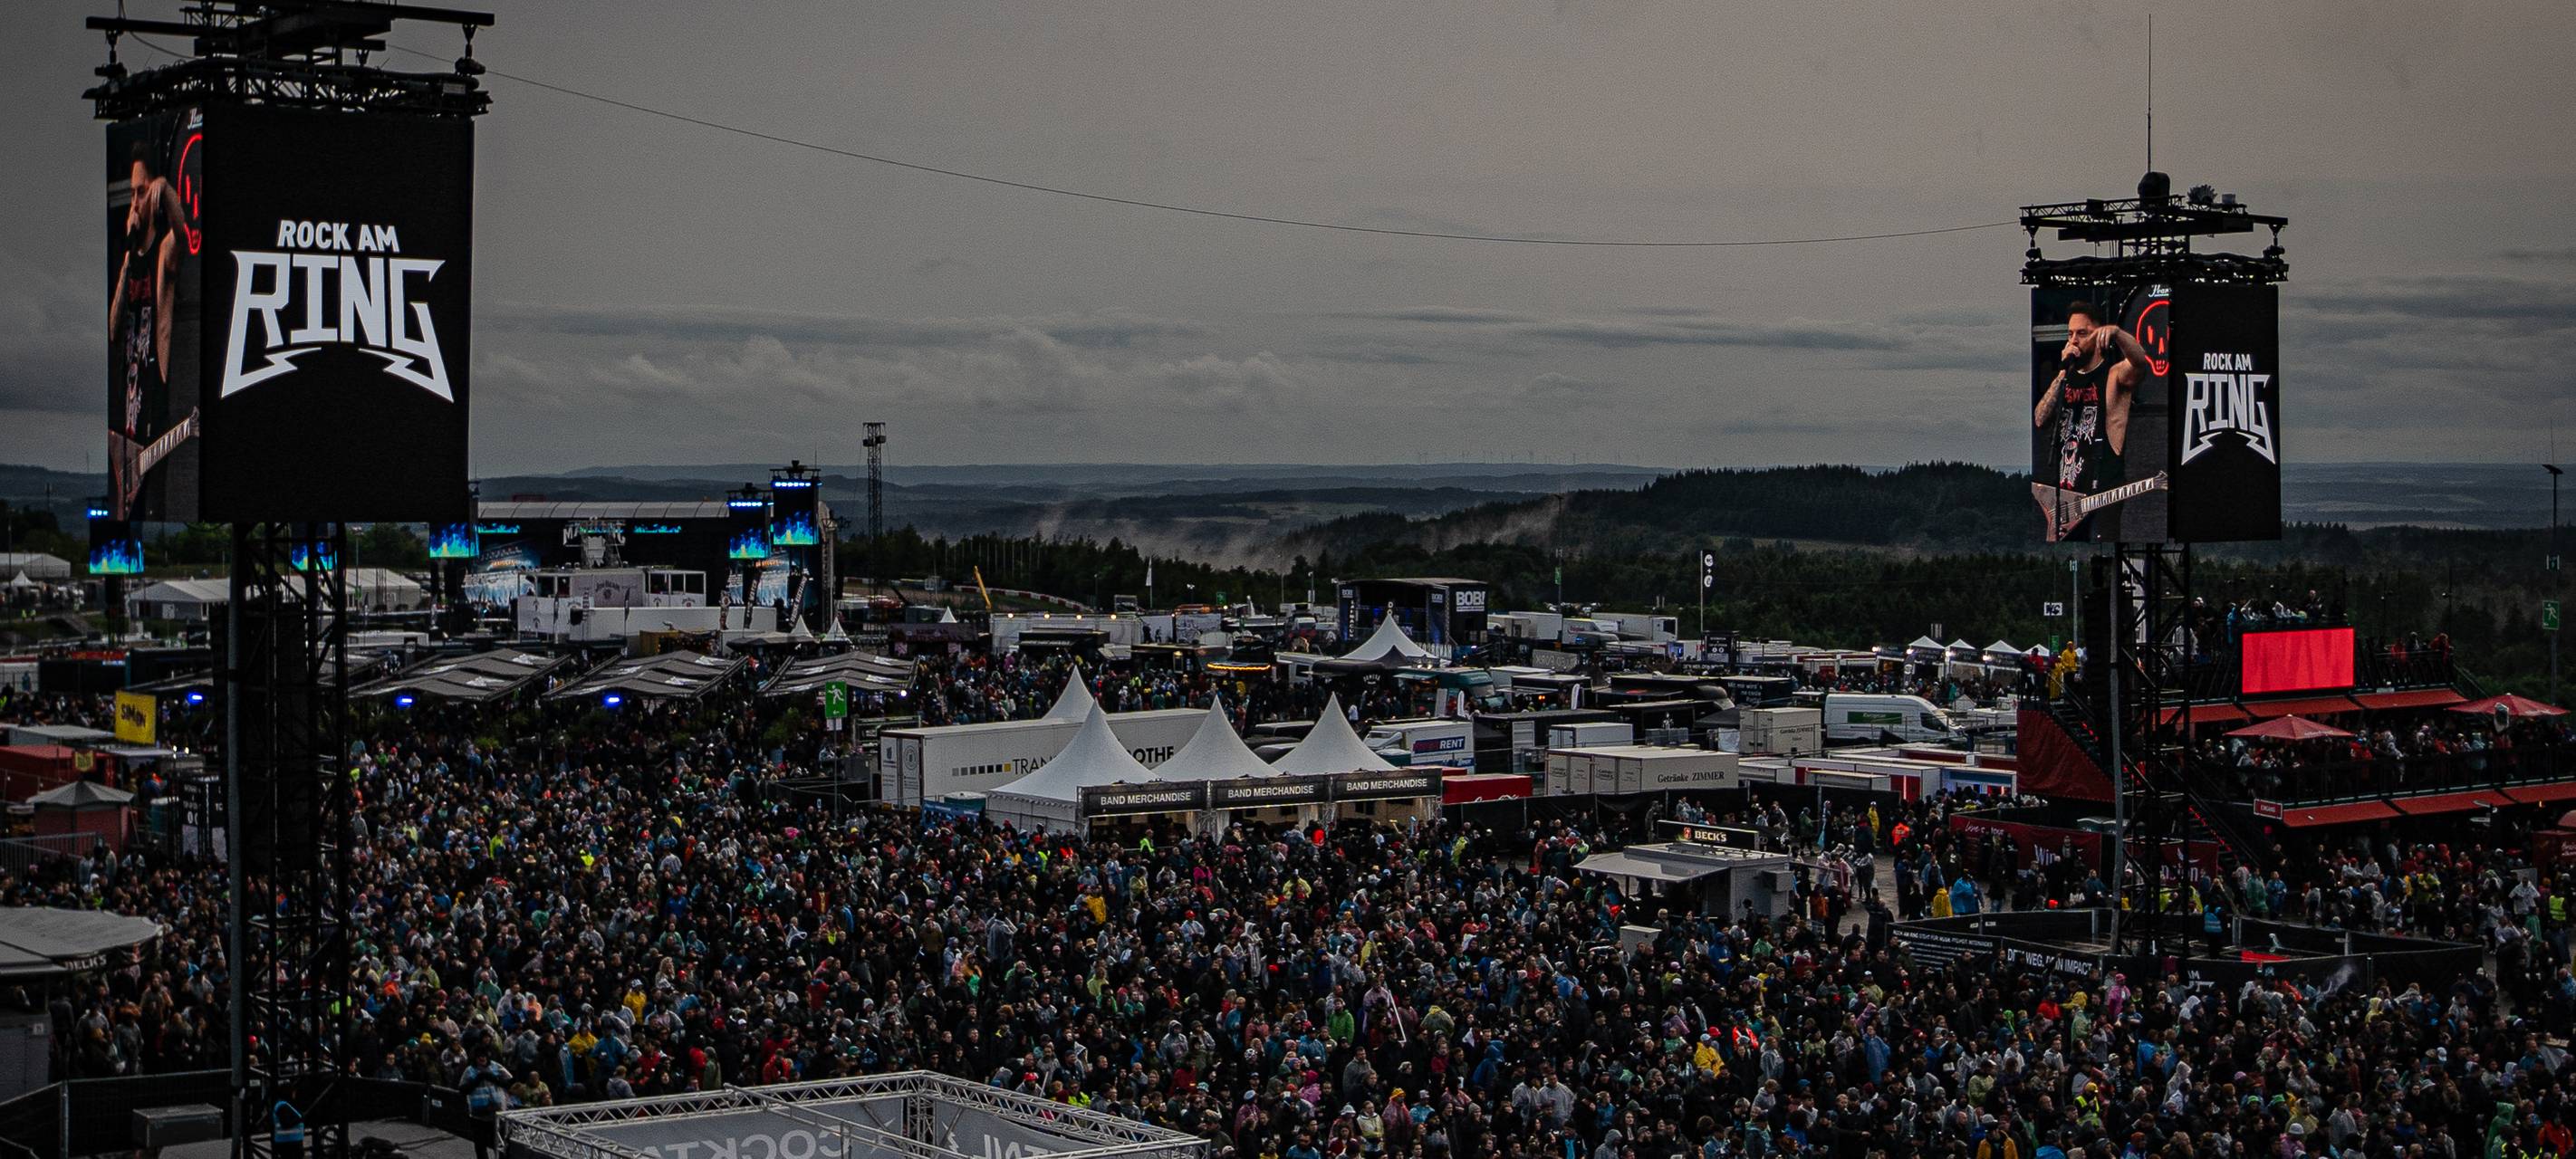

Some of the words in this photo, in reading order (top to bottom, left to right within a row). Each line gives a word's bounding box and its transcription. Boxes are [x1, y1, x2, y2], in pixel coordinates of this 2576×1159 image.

[277, 220, 356, 248] ROCK
[357, 225, 400, 253] AM
[221, 250, 454, 402] RING
[2203, 353, 2233, 370] ROCK
[2235, 354, 2253, 371] AM
[2181, 372, 2275, 465] RING
[1456, 590, 1485, 606] BOB!
[1440, 738, 1465, 750] RENT
[1126, 746, 1174, 764] OTHE
[1012, 753, 1058, 775] TRAN
[1346, 781, 1370, 791] BAND
[1370, 778, 1428, 790] MERCHANDISE
[1658, 773, 1688, 783] Getränke
[1691, 771, 1725, 781] ZIMMER
[1101, 796, 1125, 806] BAND
[1127, 791, 1192, 805] MERCHANDISE
[1227, 789, 1252, 799] BAND
[1254, 785, 1314, 797] MERCHANDISE
[1694, 829, 1727, 842] BECK'S
